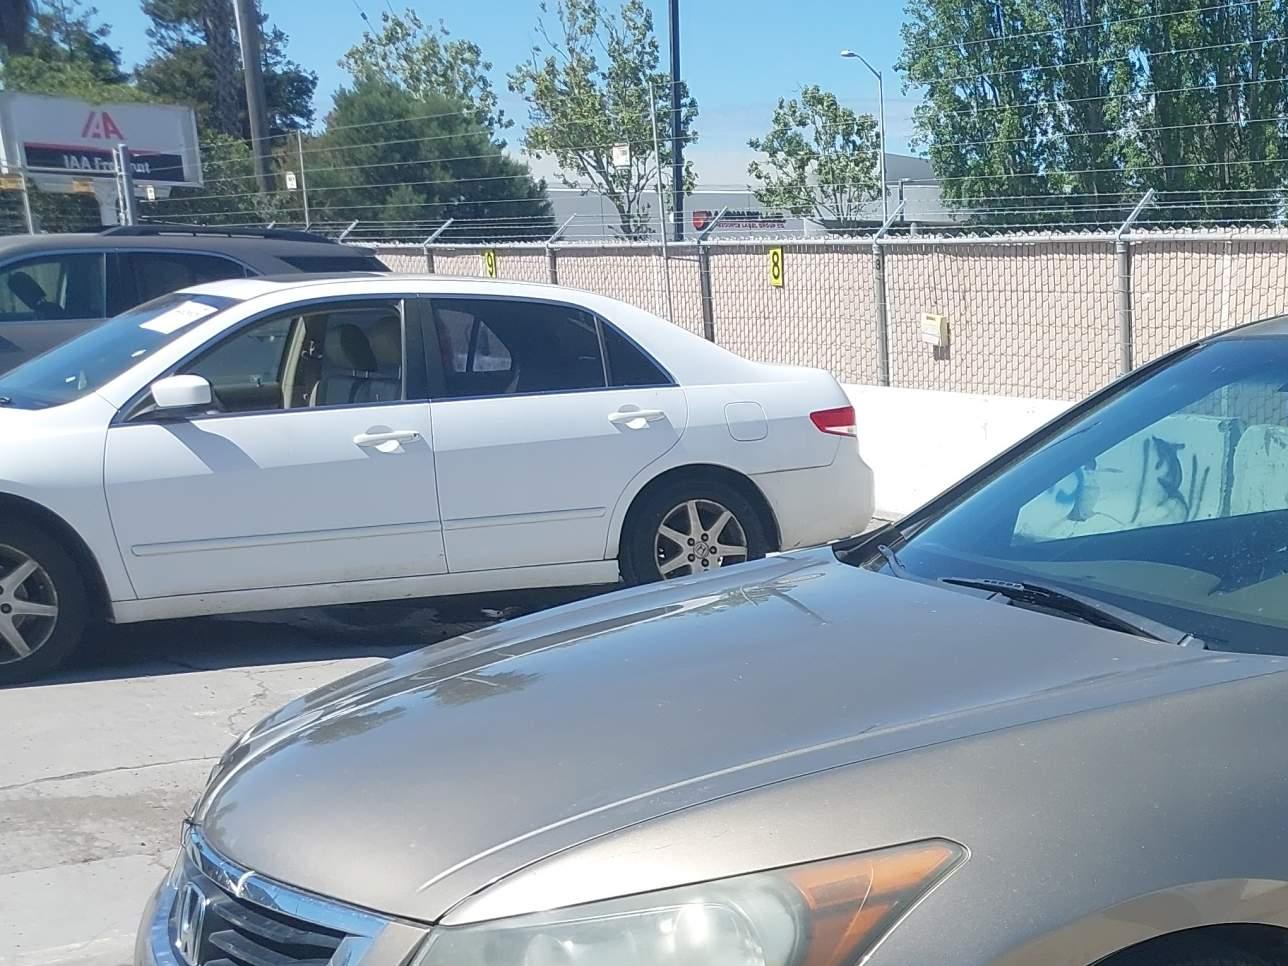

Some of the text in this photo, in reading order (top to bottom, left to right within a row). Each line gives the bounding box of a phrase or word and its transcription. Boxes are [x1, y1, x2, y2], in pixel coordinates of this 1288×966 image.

[63, 155, 92, 170] IAA
[487, 251, 494, 277] 9
[771, 250, 780, 280] 8
